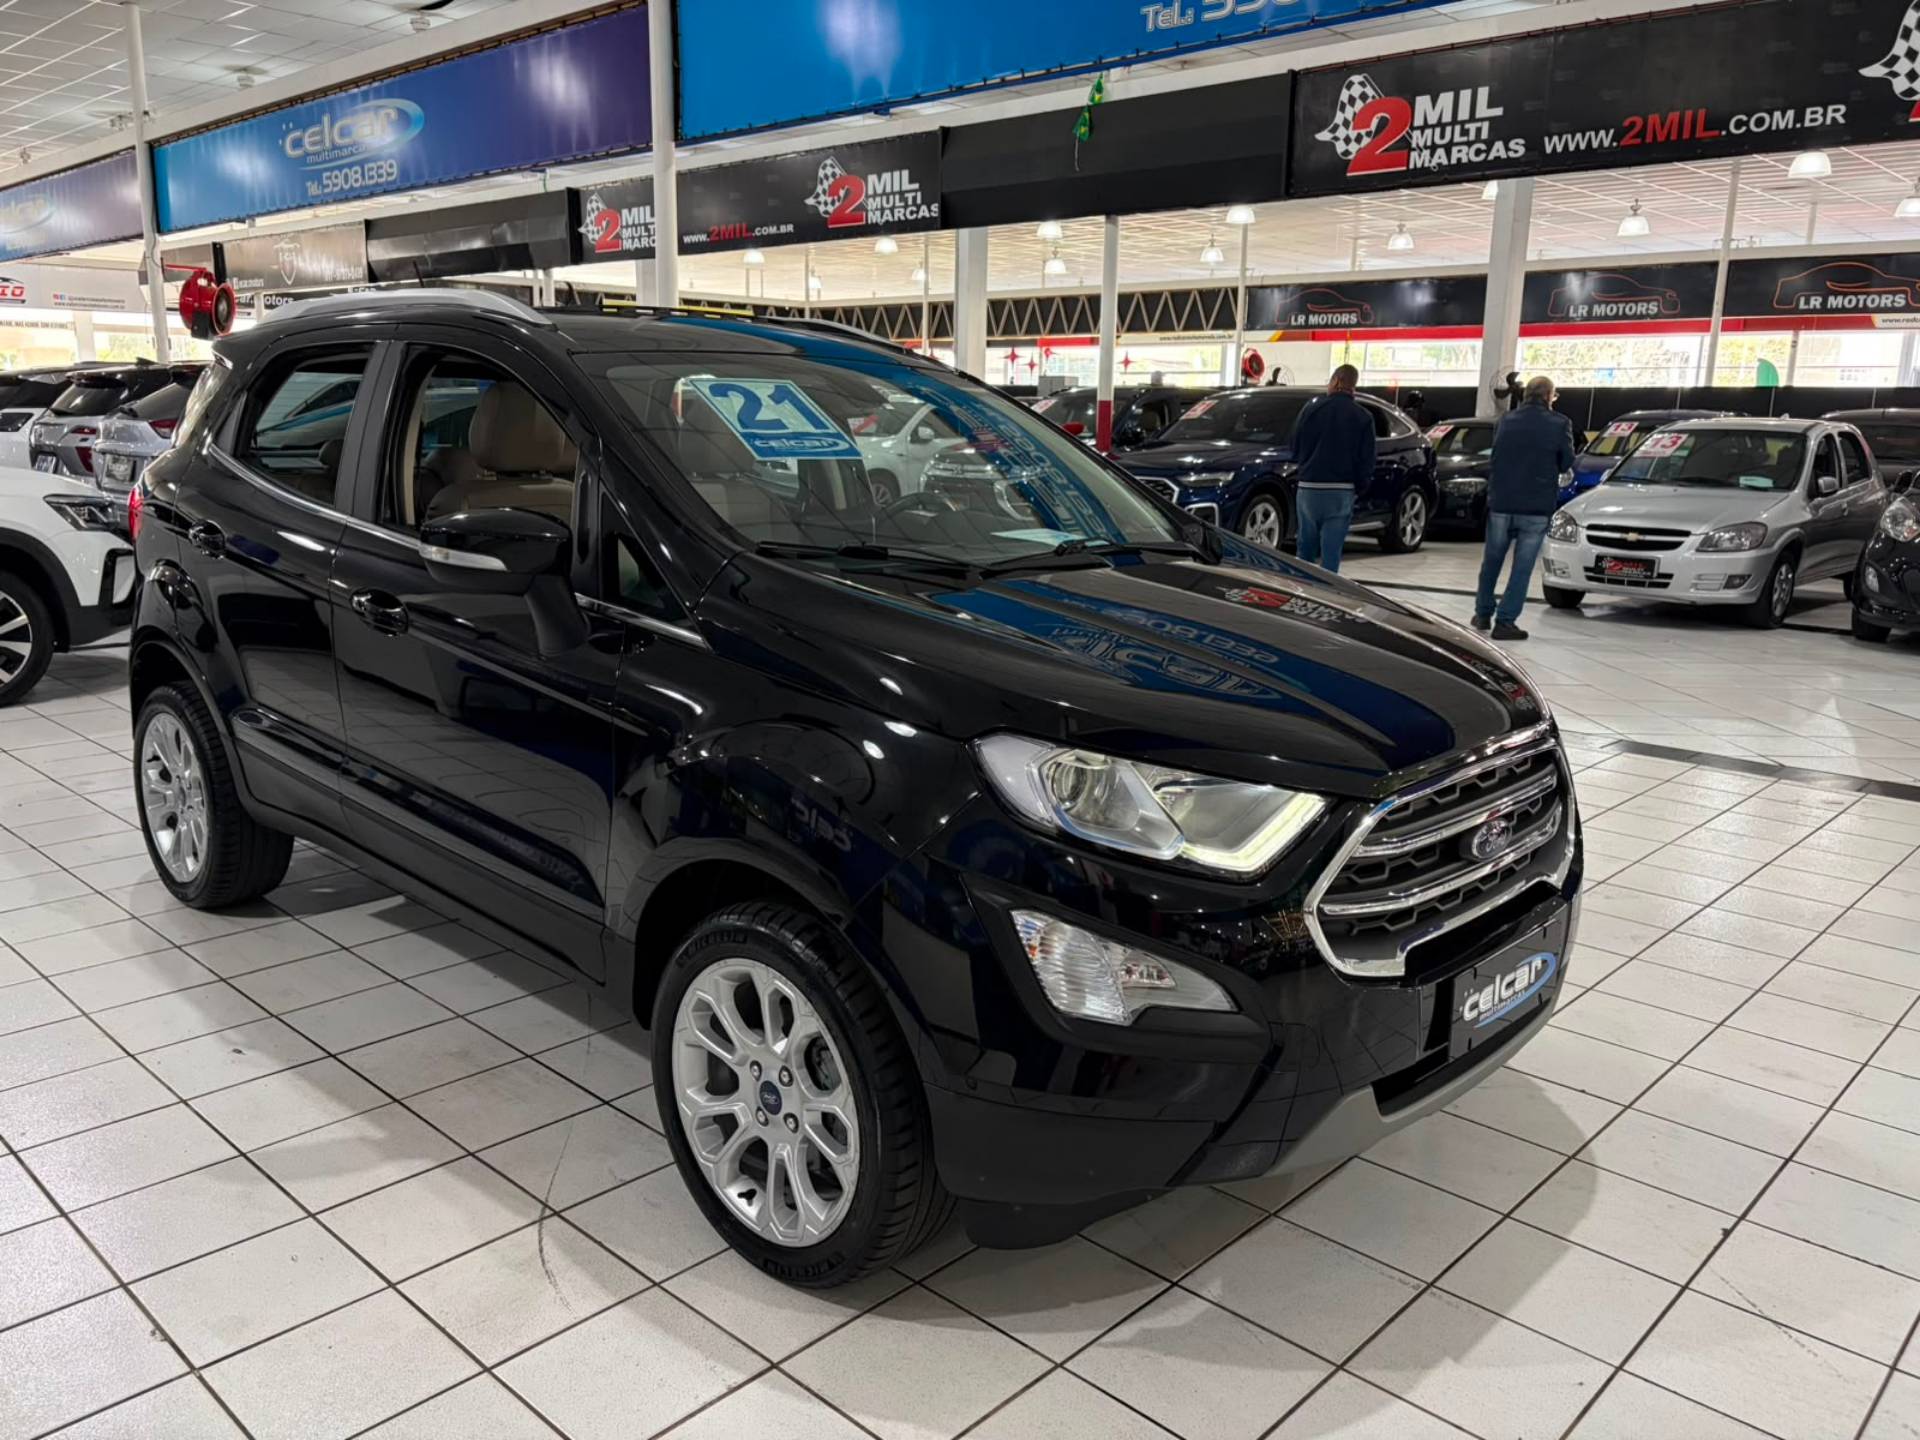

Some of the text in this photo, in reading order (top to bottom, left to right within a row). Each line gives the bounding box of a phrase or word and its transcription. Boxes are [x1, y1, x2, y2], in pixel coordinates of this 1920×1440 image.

[285, 108, 398, 158] celcar
[1346, 86, 1503, 176] 2 MIL
[1411, 121, 1490, 148] MULTI
[1409, 138, 1526, 170] MARCAS
[322, 159, 398, 193] 5908.1339
[827, 169, 920, 229] 2 MIL
[867, 191, 922, 210] MULTI
[867, 203, 939, 225] MARCAS
[594, 208, 622, 253] 2
[623, 225, 656, 238] MULT
[623, 236, 656, 251] MARC
[1569, 301, 1658, 318] LR MOTORS
[1799, 293, 1907, 310] LR MOTORS
[1290, 313, 1358, 326] LR MOTORS
[709, 383, 831, 431] 21
[1463, 959, 1542, 1022] celcar
